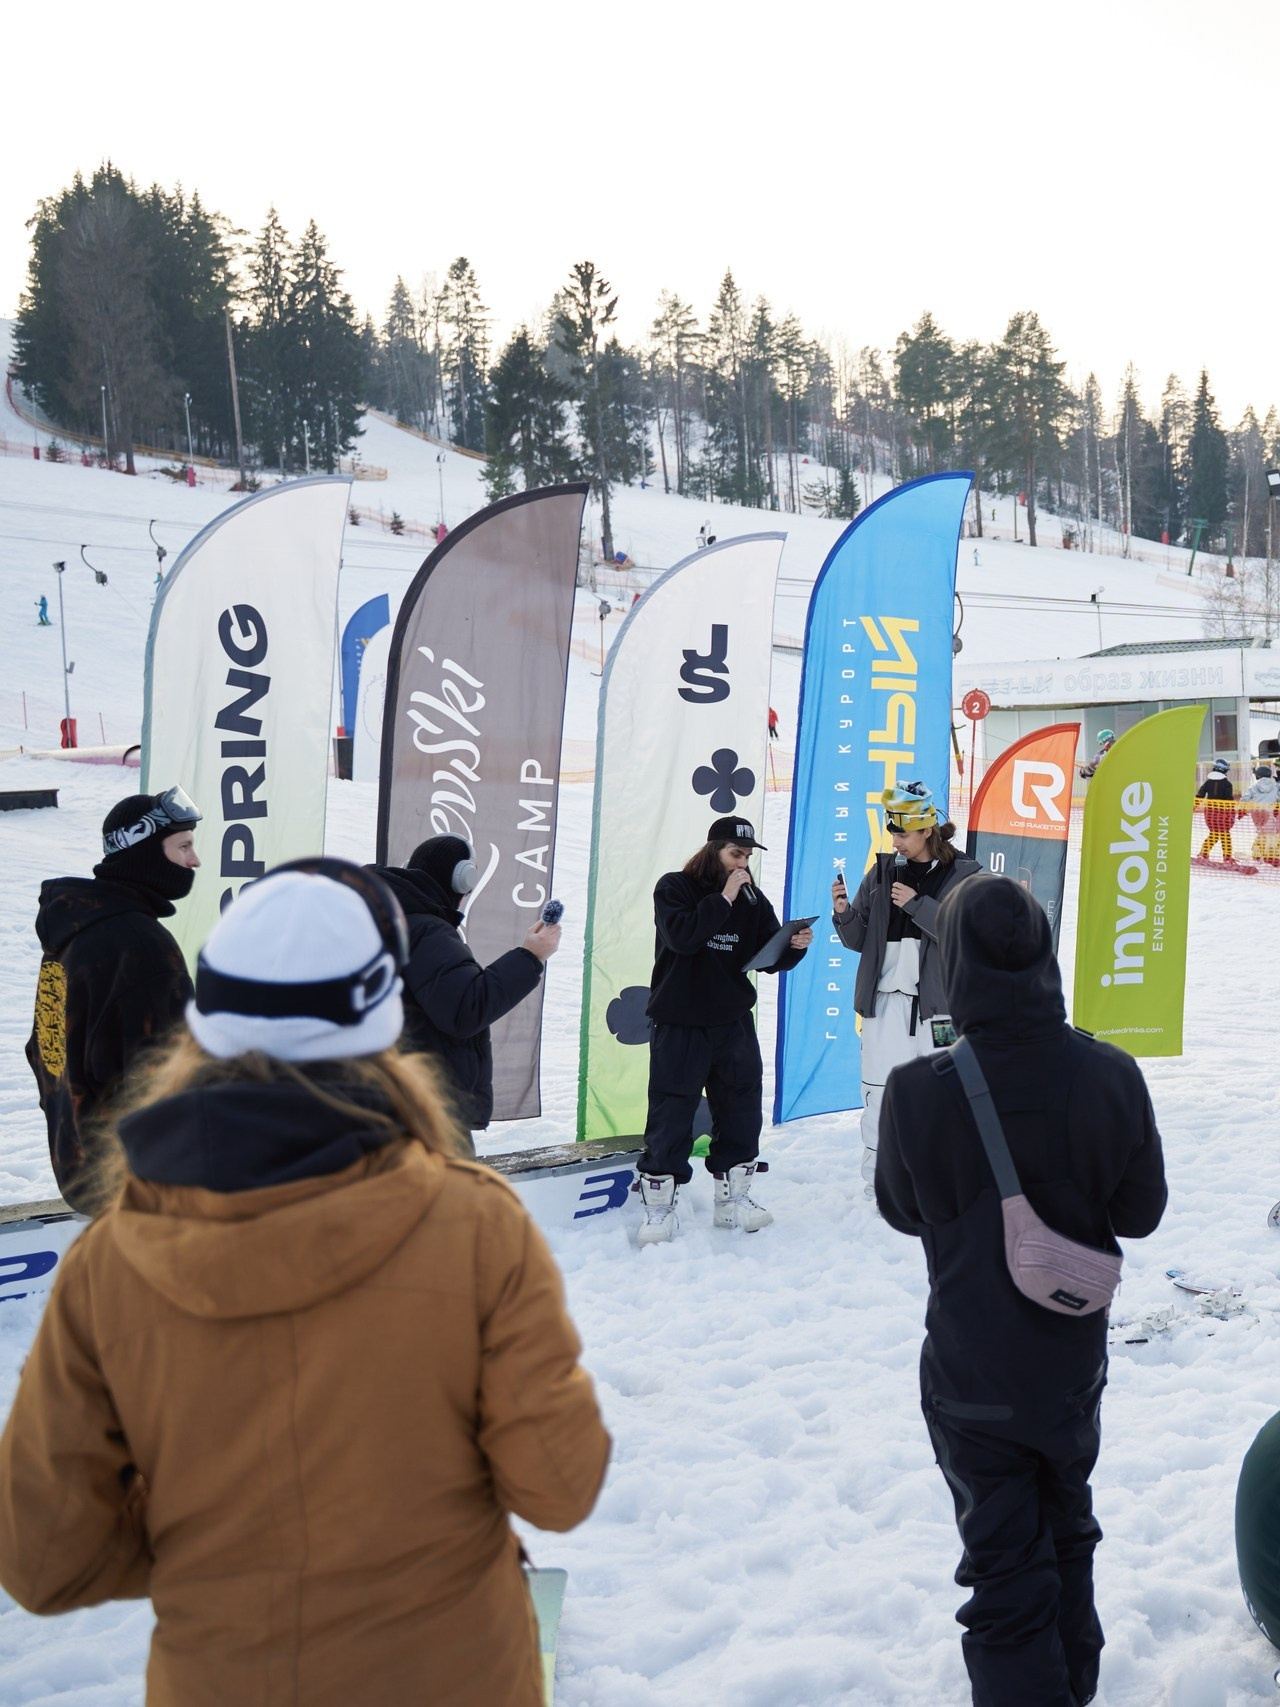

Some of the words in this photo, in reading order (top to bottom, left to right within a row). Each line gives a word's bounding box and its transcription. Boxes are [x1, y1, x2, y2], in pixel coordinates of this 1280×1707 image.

[838, 618, 857, 753] КУРОРТ
[971, 701, 980, 714] 2
[1064, 666, 1132, 697] образ
[1139, 666, 1224, 689] жизни
[512, 758, 554, 908] CAMP
[1157, 815, 1170, 873] DRINK
[1101, 781, 1153, 988] invoke
[1152, 878, 1167, 952] ENERGY
